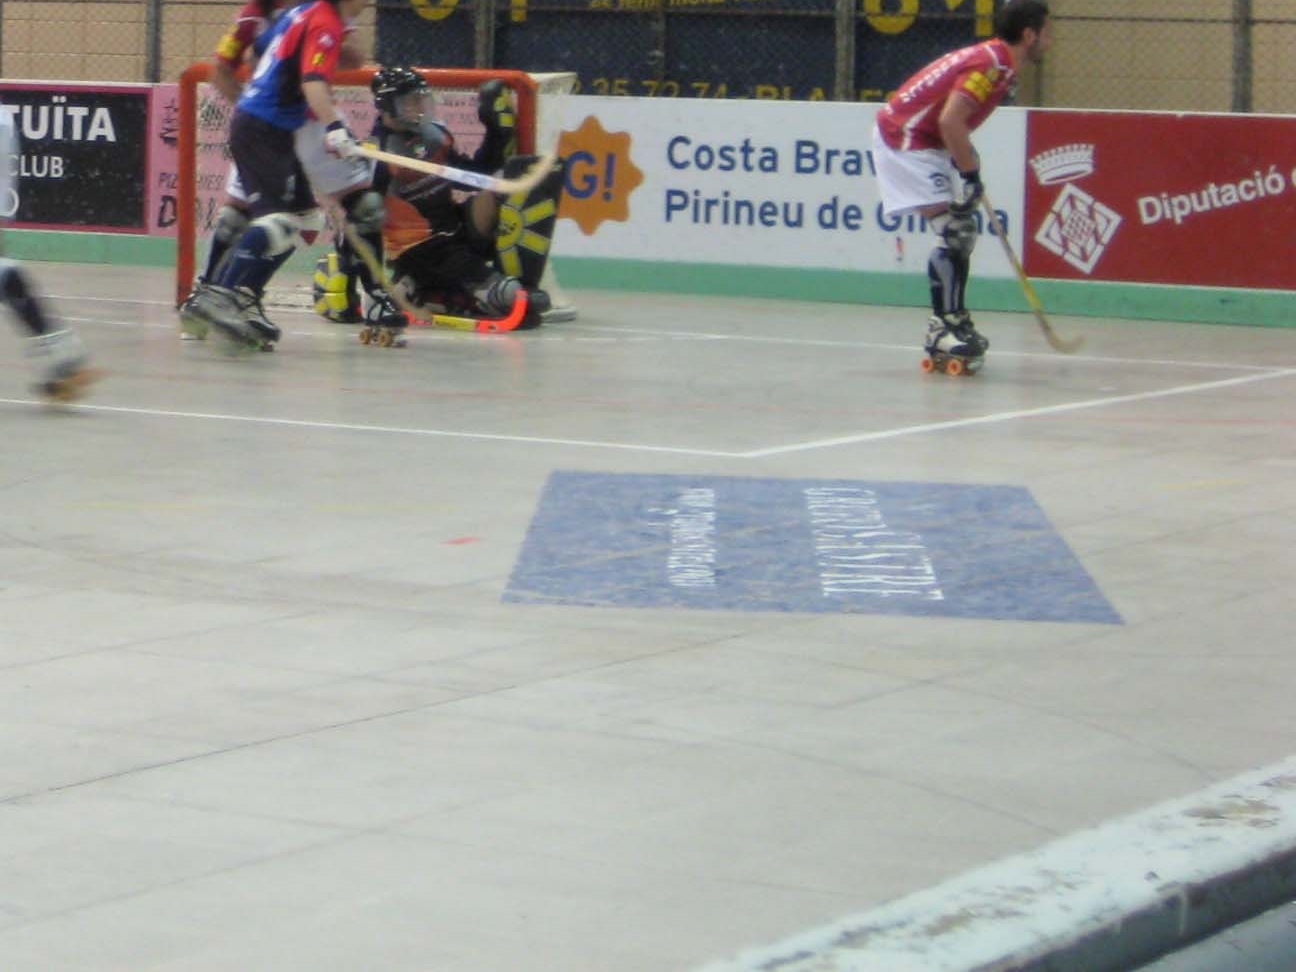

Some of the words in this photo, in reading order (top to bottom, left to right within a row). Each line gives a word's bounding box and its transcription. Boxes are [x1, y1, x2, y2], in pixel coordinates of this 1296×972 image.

[667, 135, 779, 172] Costa
[665, 189, 803, 228] Pirineu
[817, 195, 863, 230] de
[1137, 164, 1286, 226] Diputació
